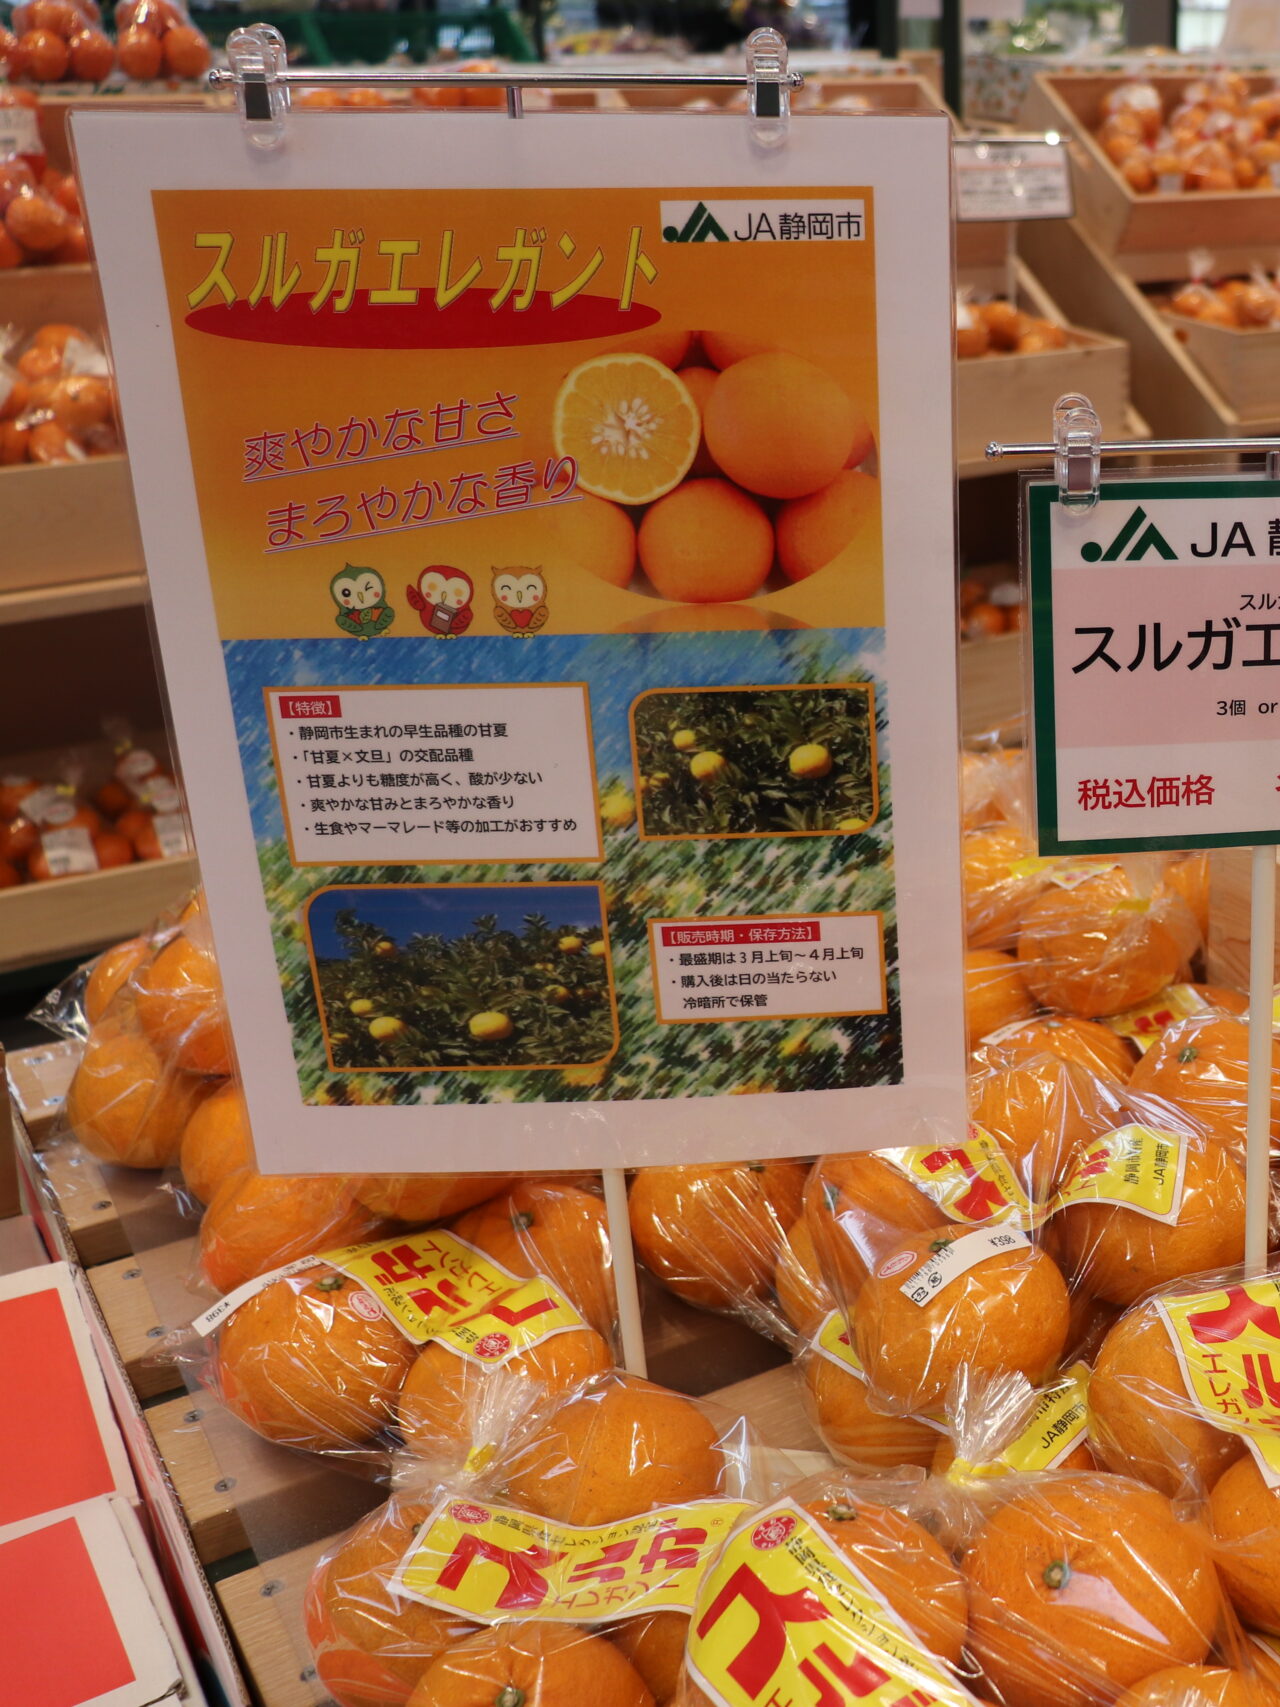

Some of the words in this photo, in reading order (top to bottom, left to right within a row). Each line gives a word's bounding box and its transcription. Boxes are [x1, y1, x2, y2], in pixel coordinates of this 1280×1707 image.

[734, 210, 864, 242] JA静岡市
[185, 225, 659, 314] スルガエレガント
[243, 390, 520, 477] 爽やかな甘さ
[262, 453, 583, 552] まろやかな香り
[1190, 521, 1256, 558] JA
[1216, 699, 1247, 717] 3個
[1257, 701, 1279, 716] or
[1077, 774, 1216, 812] 税込価格
[683, 993, 768, 1011] 冷暗所で保管
[436, 1517, 708, 1610] スルガ
